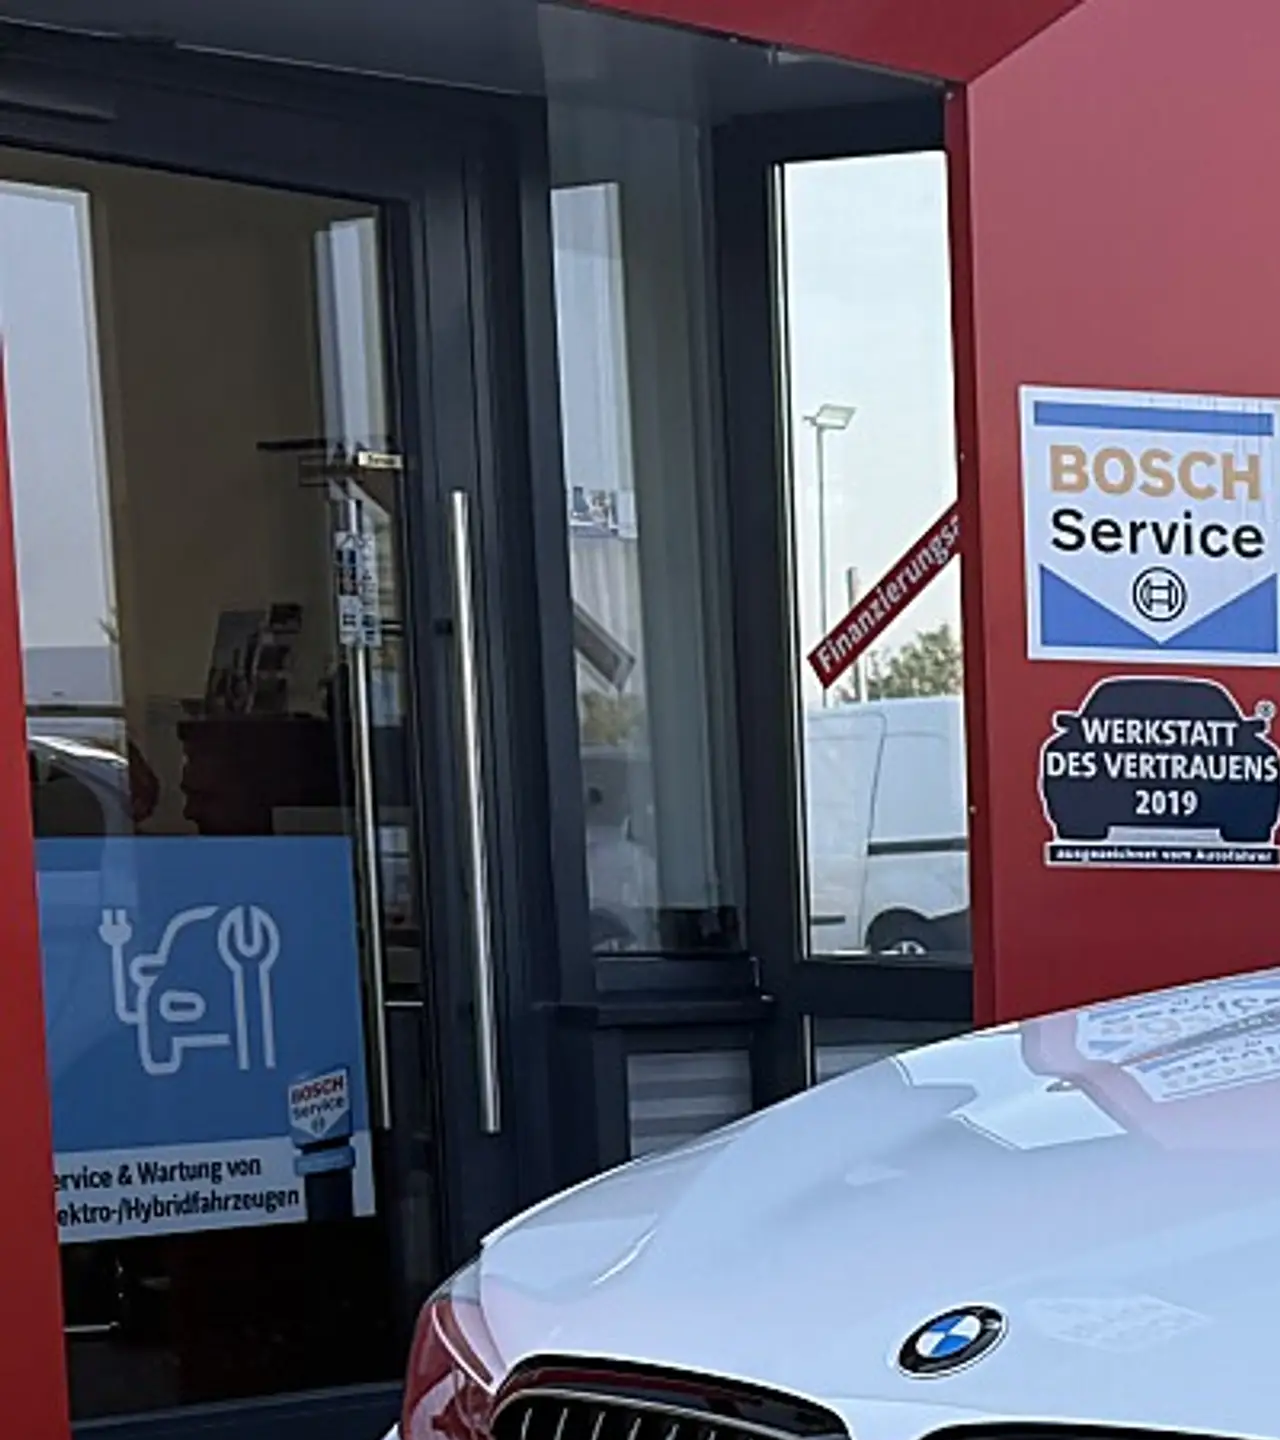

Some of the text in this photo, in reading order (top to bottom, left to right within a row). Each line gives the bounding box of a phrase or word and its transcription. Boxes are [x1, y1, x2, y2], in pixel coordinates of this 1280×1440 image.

[1049, 443, 1261, 502] BOSCH
[1051, 507, 1265, 559] Service
[1080, 716, 1240, 748] WERKSTATT
[1046, 750, 1280, 783] DES VERTRAUENS
[1134, 789, 1200, 817] 2019
[291, 1074, 345, 1106] BOSCH
[117, 1164, 133, 1186] &
[136, 1158, 223, 1185] Wartung
[226, 1156, 262, 1177] von
